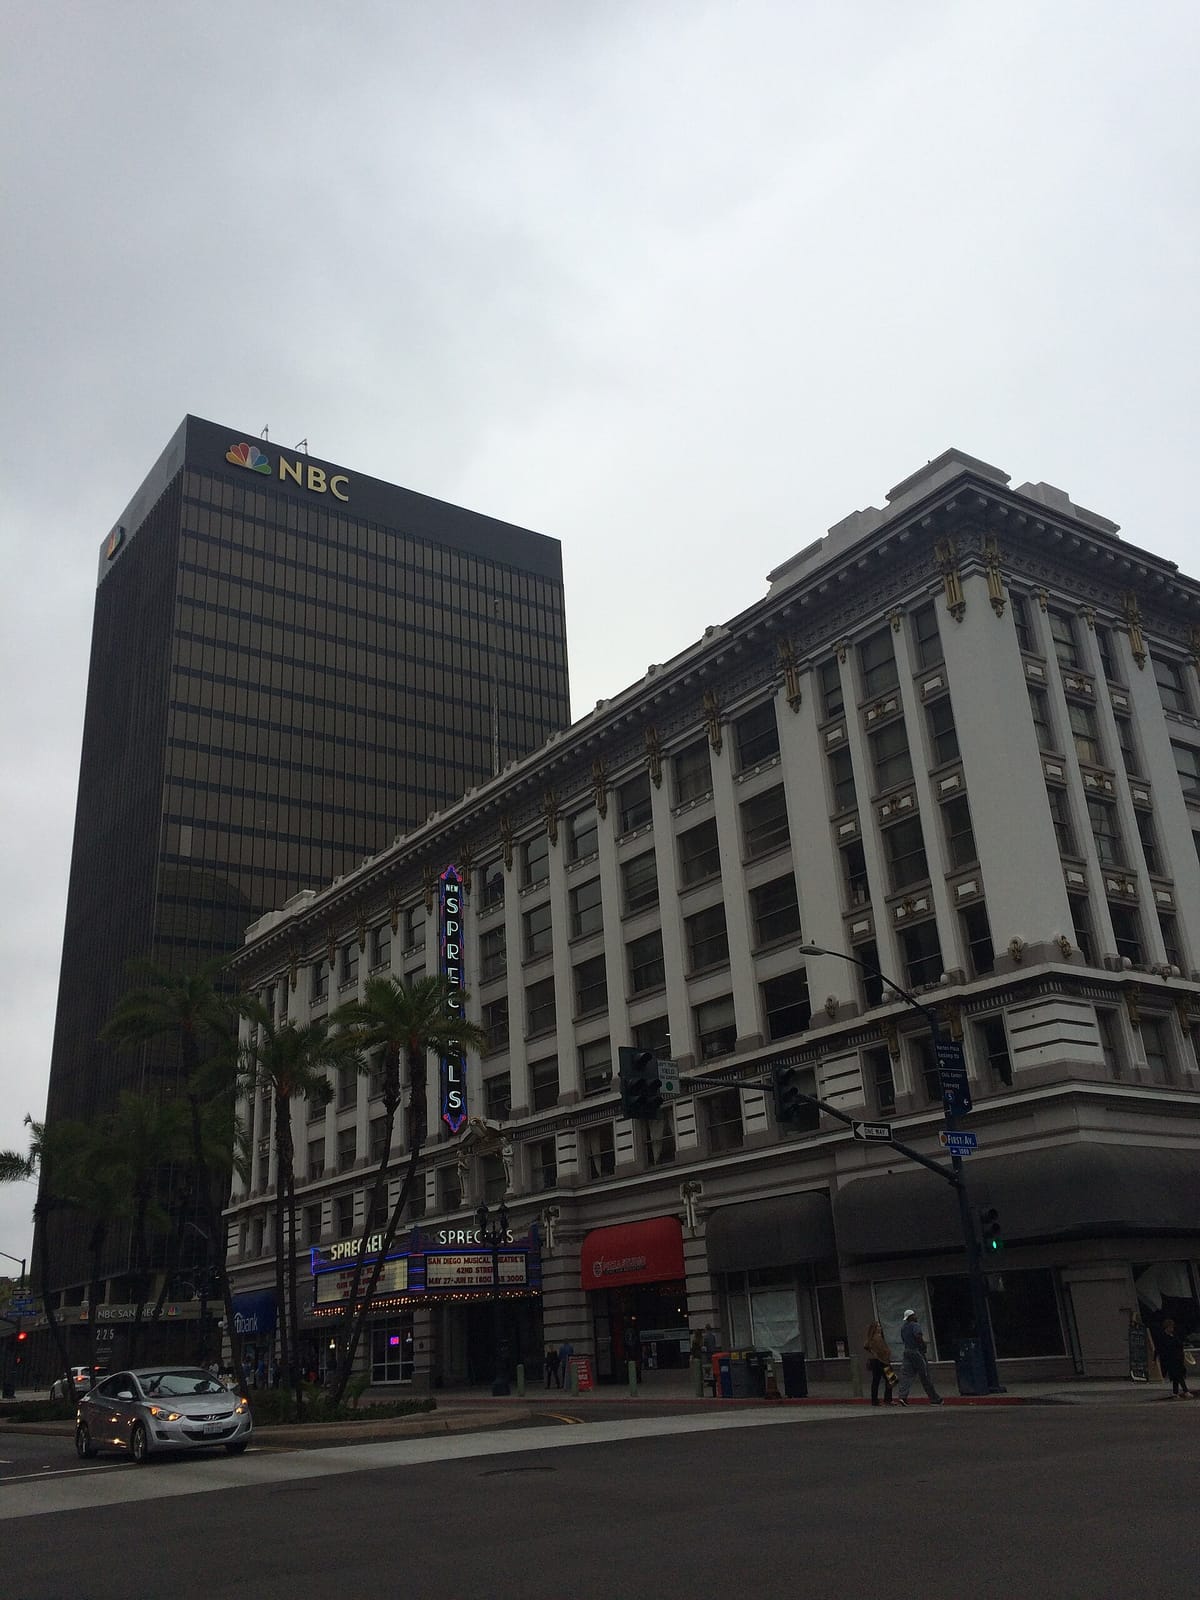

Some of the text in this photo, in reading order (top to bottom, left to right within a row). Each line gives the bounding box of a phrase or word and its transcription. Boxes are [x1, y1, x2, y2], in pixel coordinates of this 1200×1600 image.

[279, 455, 349, 502] NBC
[446, 898, 462, 1108] SPRECELS
[864, 1127, 888, 1136] ONE WAY
[428, 1257, 441, 1265] SAN
[443, 1257, 461, 1265] DIEGO
[464, 1256, 491, 1264] MUSICAL
[456, 1266, 473, 1274] 42ND
[428, 1277, 441, 1285] MAY
[97, 1309, 115, 1320] NBC
[118, 1308, 136, 1319] SAN
